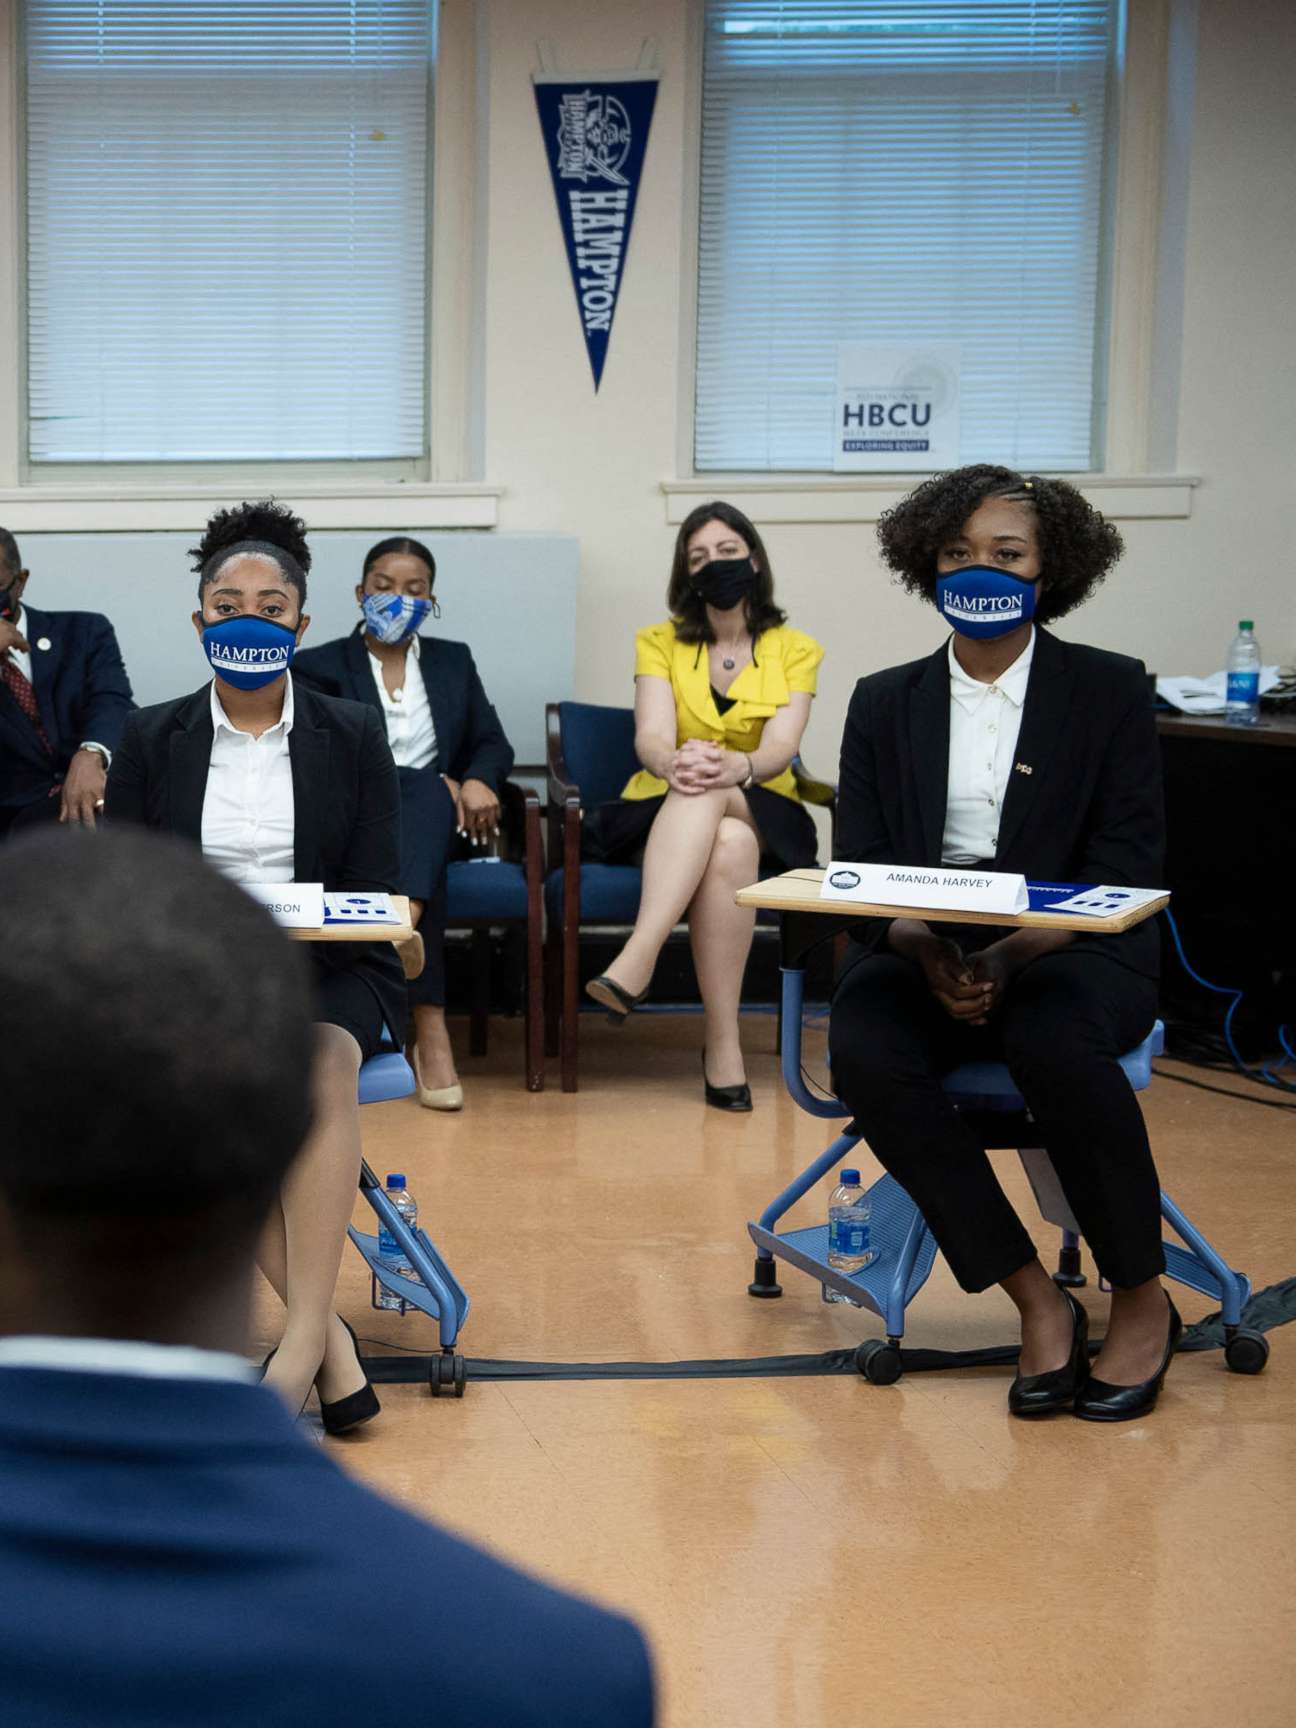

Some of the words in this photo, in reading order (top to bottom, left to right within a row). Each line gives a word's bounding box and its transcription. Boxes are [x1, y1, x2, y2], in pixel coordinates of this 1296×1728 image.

[568, 188, 629, 332] HAMPTON
[843, 403, 931, 428] HBCU
[943, 589, 1023, 612] HAMPTON
[209, 641, 291, 662] HAMPTON
[886, 871, 941, 886] AMANDA
[942, 876, 994, 889] HARVEY
[263, 903, 301, 913] RSON
